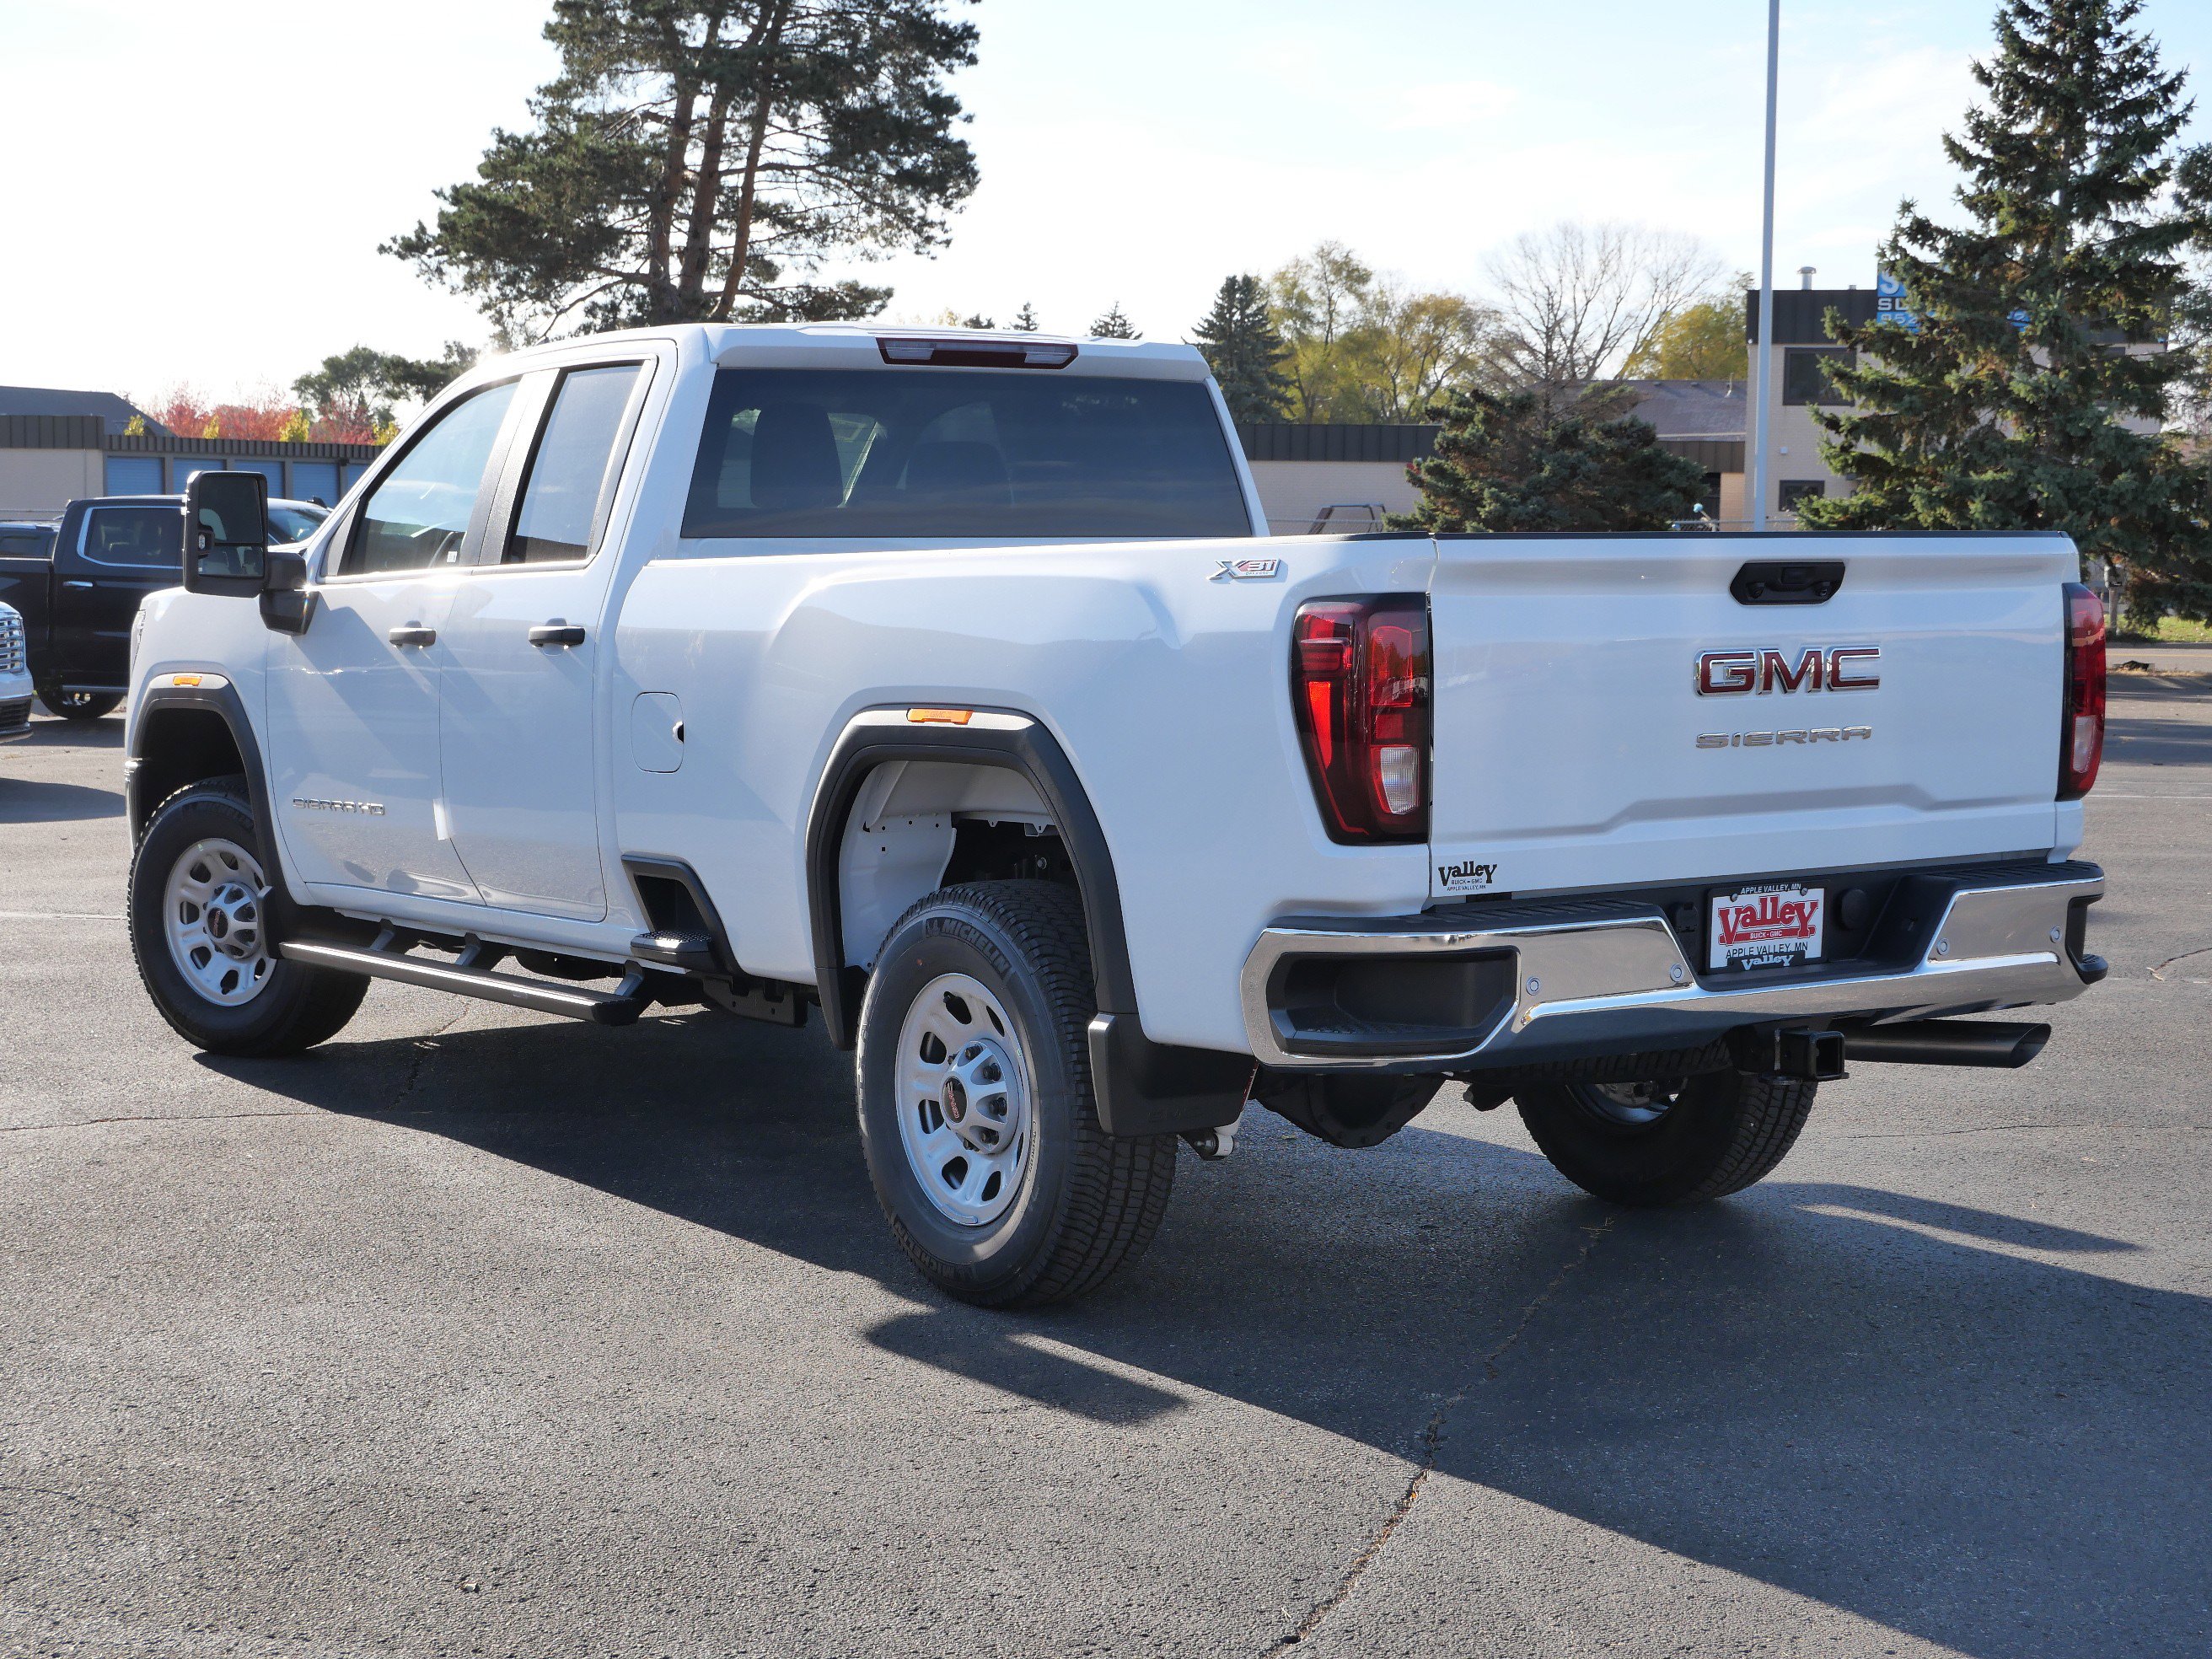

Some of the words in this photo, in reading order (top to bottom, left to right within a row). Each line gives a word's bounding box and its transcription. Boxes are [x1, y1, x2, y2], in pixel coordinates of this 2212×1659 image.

[1694, 646, 1880, 696] GMC
[1696, 725, 1872, 749] SIERRA
[293, 797, 357, 813] SIERRA
[358, 802, 385, 815] HD
[1741, 885, 1762, 894] APPLE
[1750, 931, 1766, 939] BUICK
[941, 917, 1011, 974] MICHELIN
[1726, 947, 1753, 958] APPLE
[1795, 942, 1808, 951] MN
